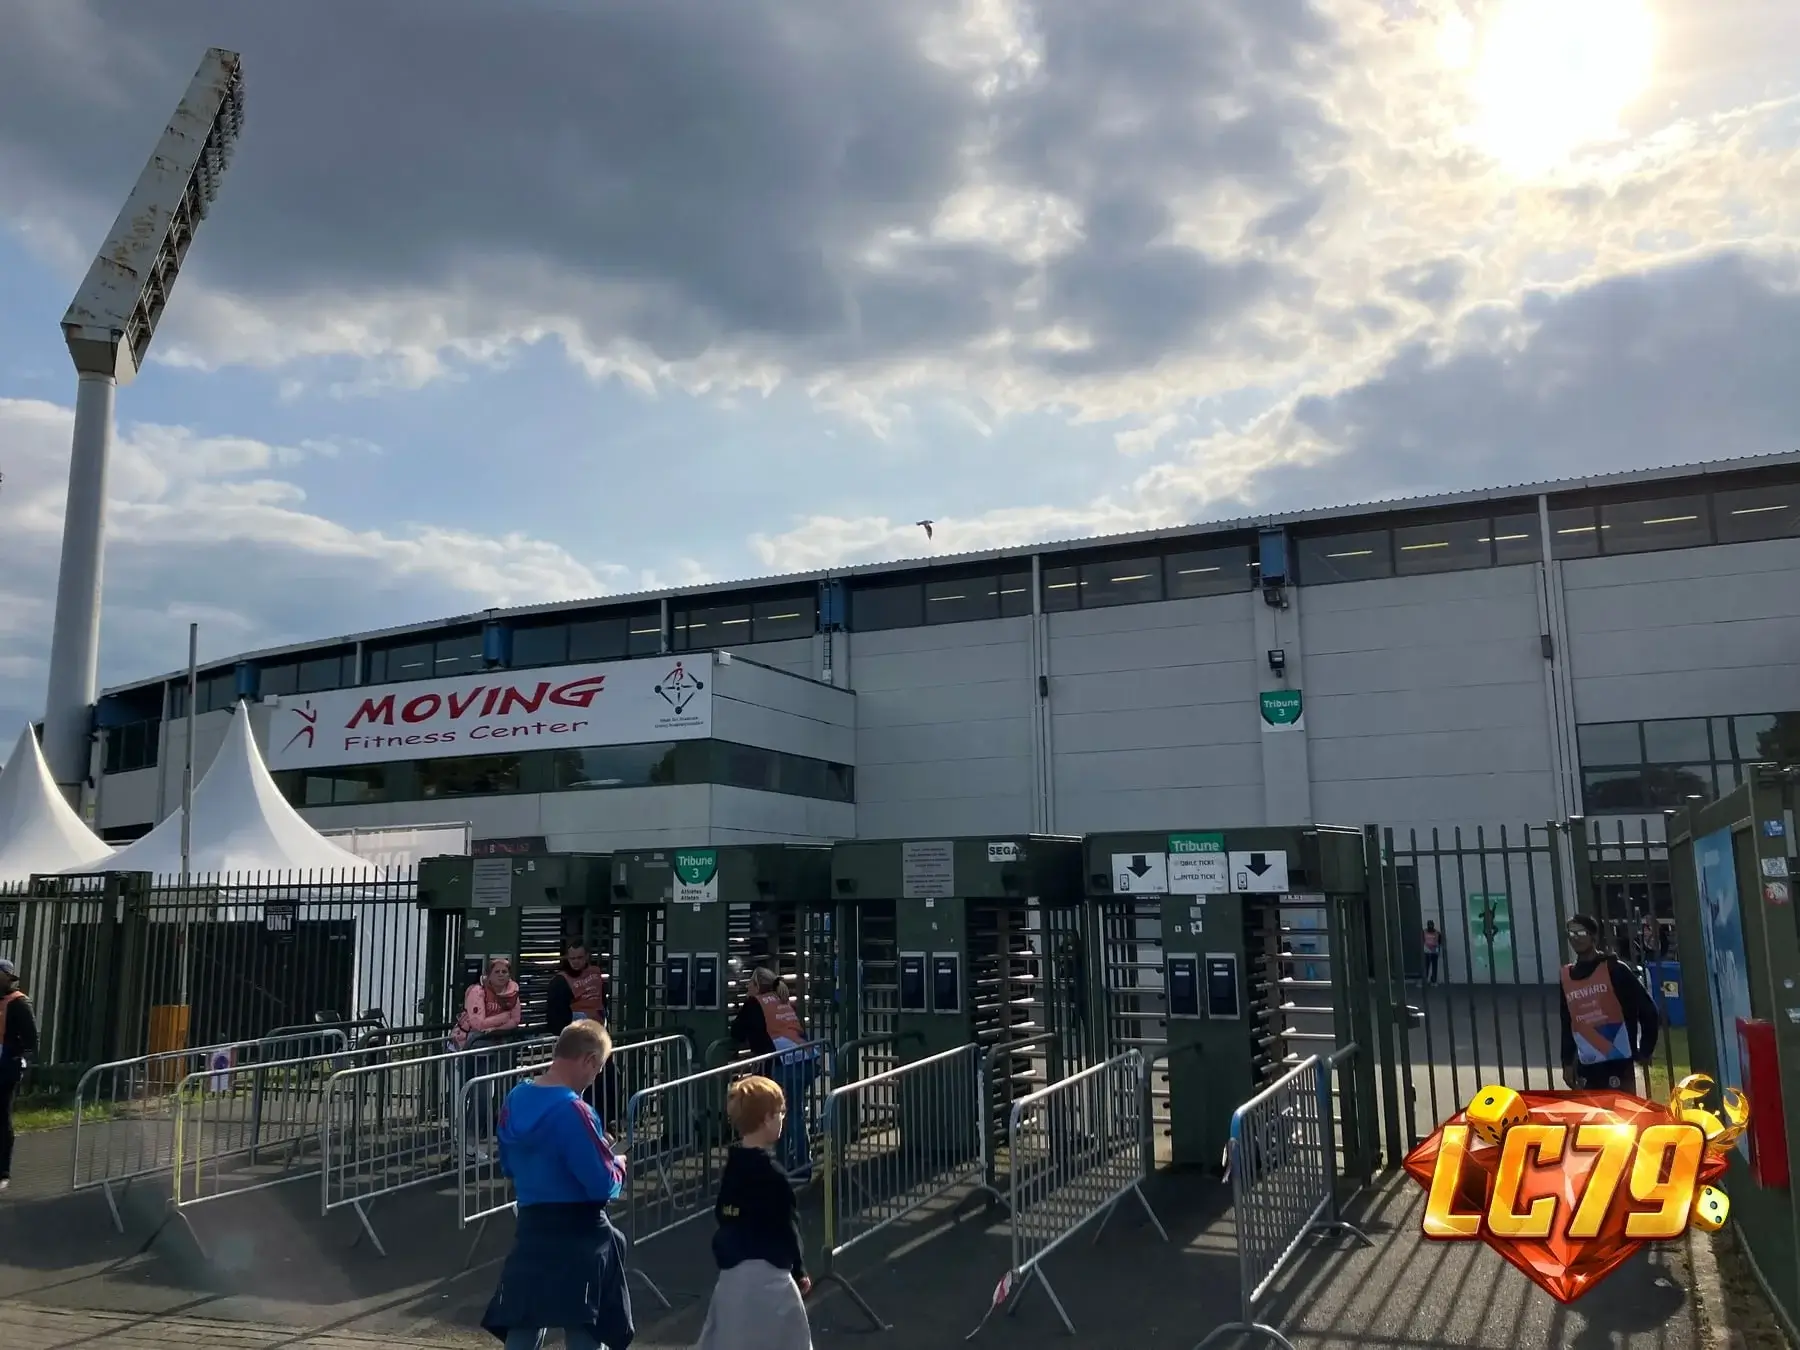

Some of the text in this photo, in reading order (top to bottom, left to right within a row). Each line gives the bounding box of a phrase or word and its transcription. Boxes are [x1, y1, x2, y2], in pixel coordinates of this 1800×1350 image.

[344, 676, 605, 729] MOVING
[1278, 709, 1285, 717] 3
[345, 721, 588, 751] Fitness Center
[1171, 840, 1220, 852] Tribune
[678, 856, 713, 866] Tribune
[692, 868, 699, 878] 3
